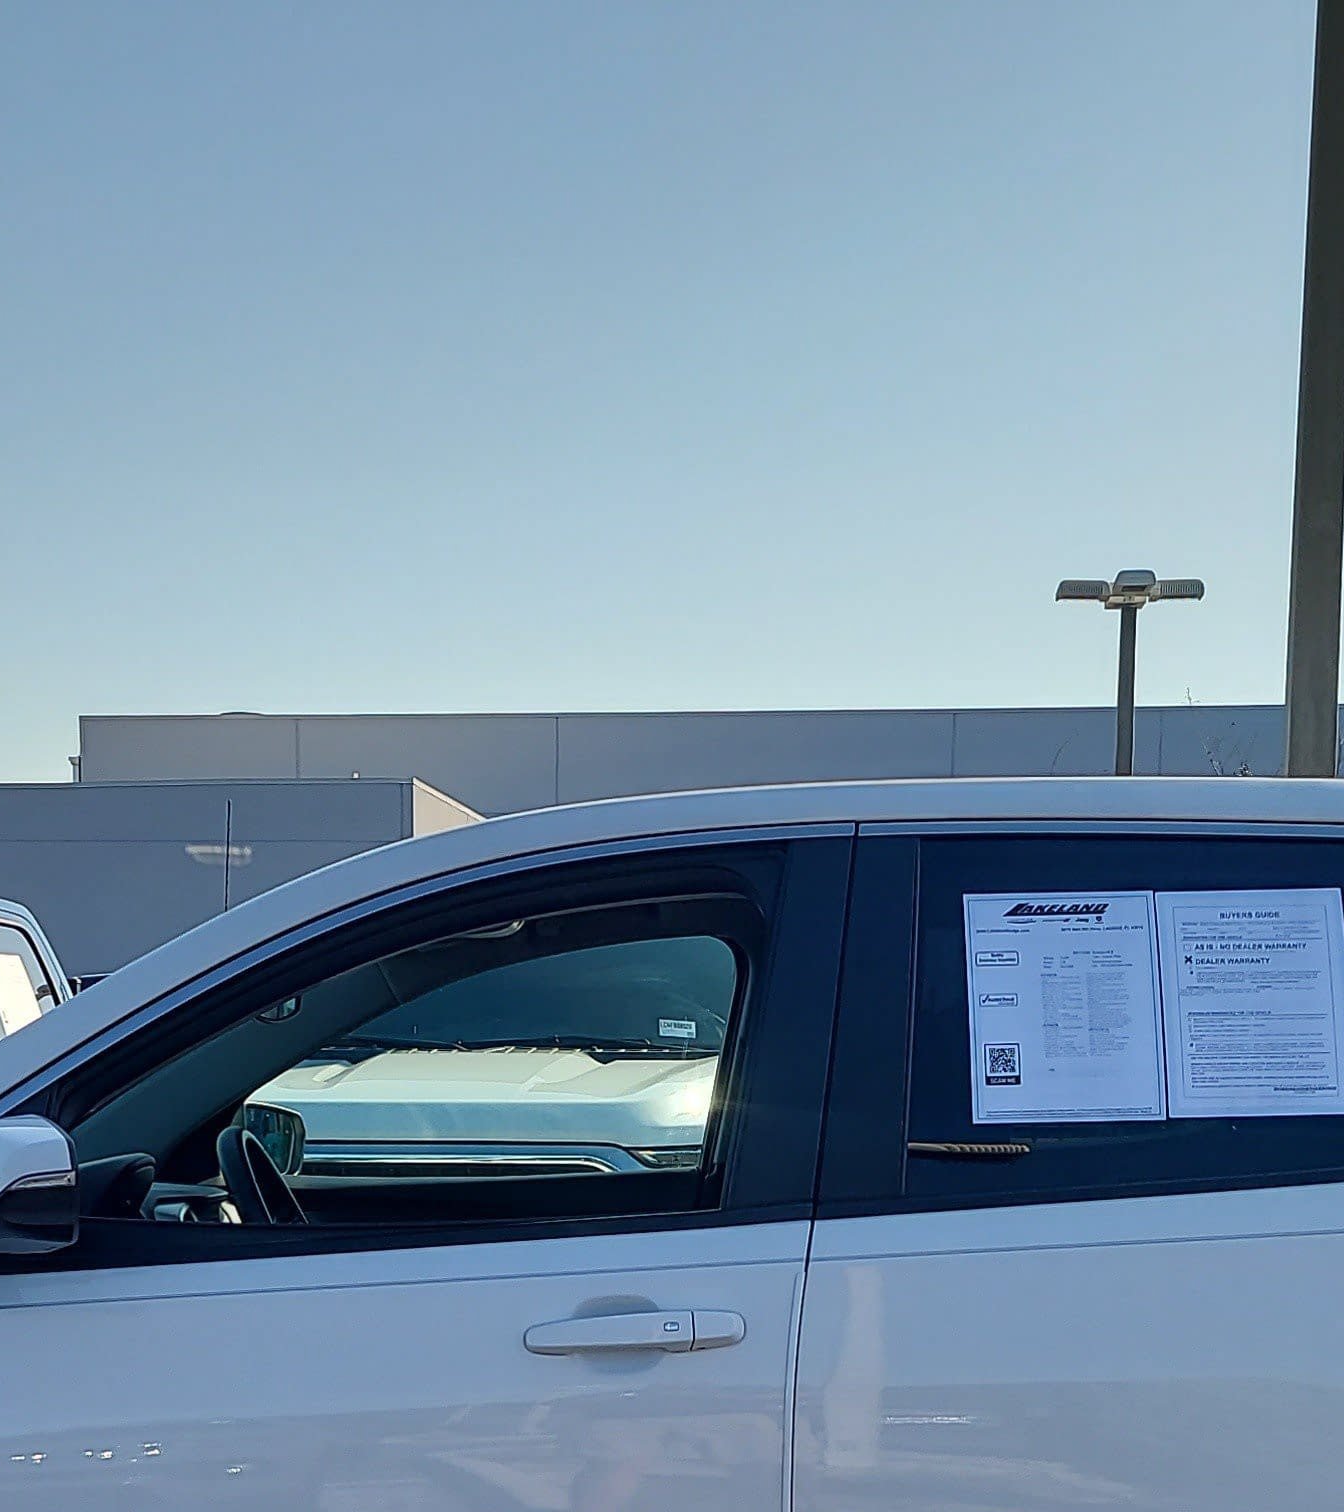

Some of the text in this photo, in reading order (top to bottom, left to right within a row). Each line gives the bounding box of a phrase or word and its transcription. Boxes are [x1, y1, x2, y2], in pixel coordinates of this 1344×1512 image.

[1003, 902, 1109, 917] LAKELAND
[1219, 911, 1280, 919] BUYERS GUIDE
[1194, 943, 1205, 951] AS
[1206, 943, 1214, 951] IS
[1219, 943, 1232, 951] NO
[1232, 942, 1263, 950] DEALER
[1264, 942, 1307, 950] WARRANTY
[1195, 957, 1226, 965] DEALER
[1227, 957, 1271, 965] WARRANTY
